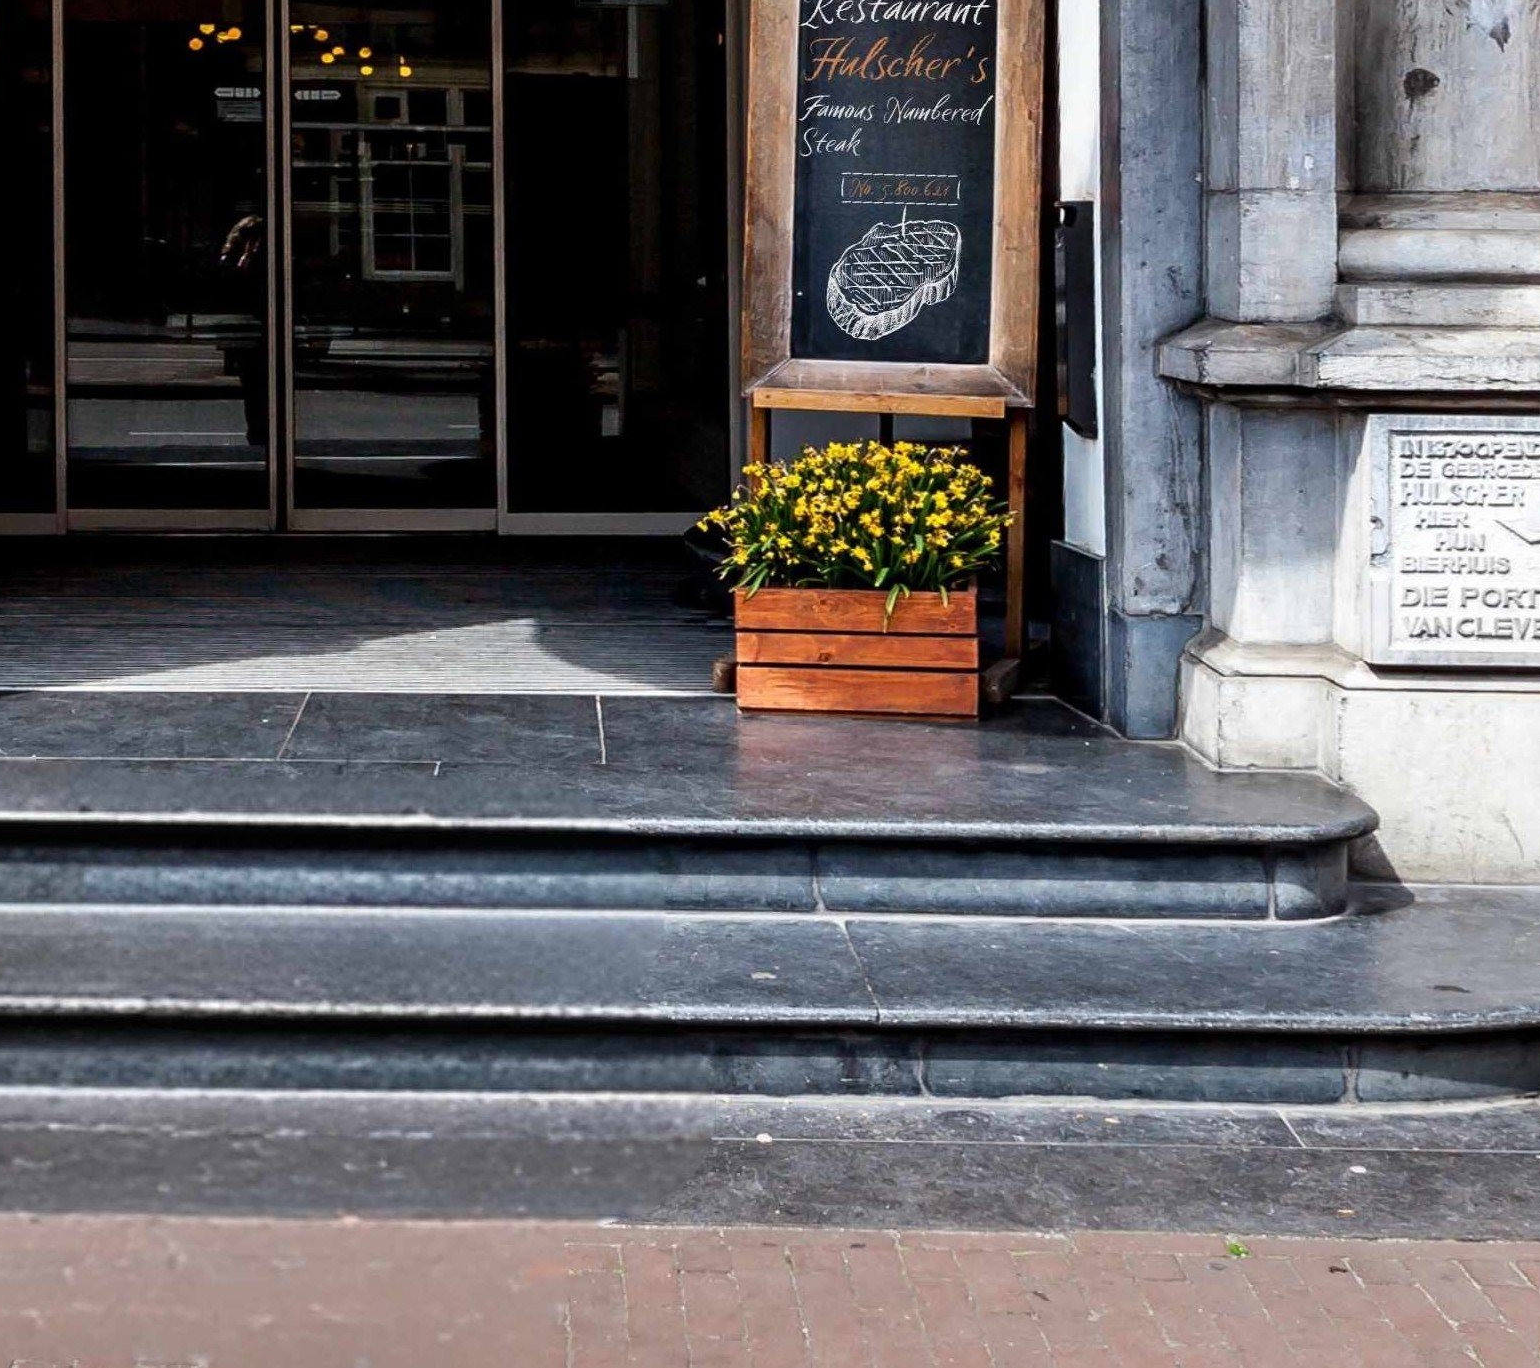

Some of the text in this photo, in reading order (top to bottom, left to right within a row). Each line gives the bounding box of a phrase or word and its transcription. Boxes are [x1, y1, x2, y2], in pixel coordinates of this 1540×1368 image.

[804, 32, 990, 83] Hulscher's
[799, 93, 994, 126] Famous Numbered
[800, 126, 861, 157] Steak
[1399, 439, 1422, 459] IN
[1400, 462, 1432, 479] DE
[1400, 483, 1526, 507] HULSCHER
[1415, 511, 1471, 529] HIER
[1434, 532, 1487, 552] HUN
[1400, 556, 1511, 575] BIERHUIS
[1400, 587, 1449, 608] DIE
[1404, 616, 1453, 639] VAN
